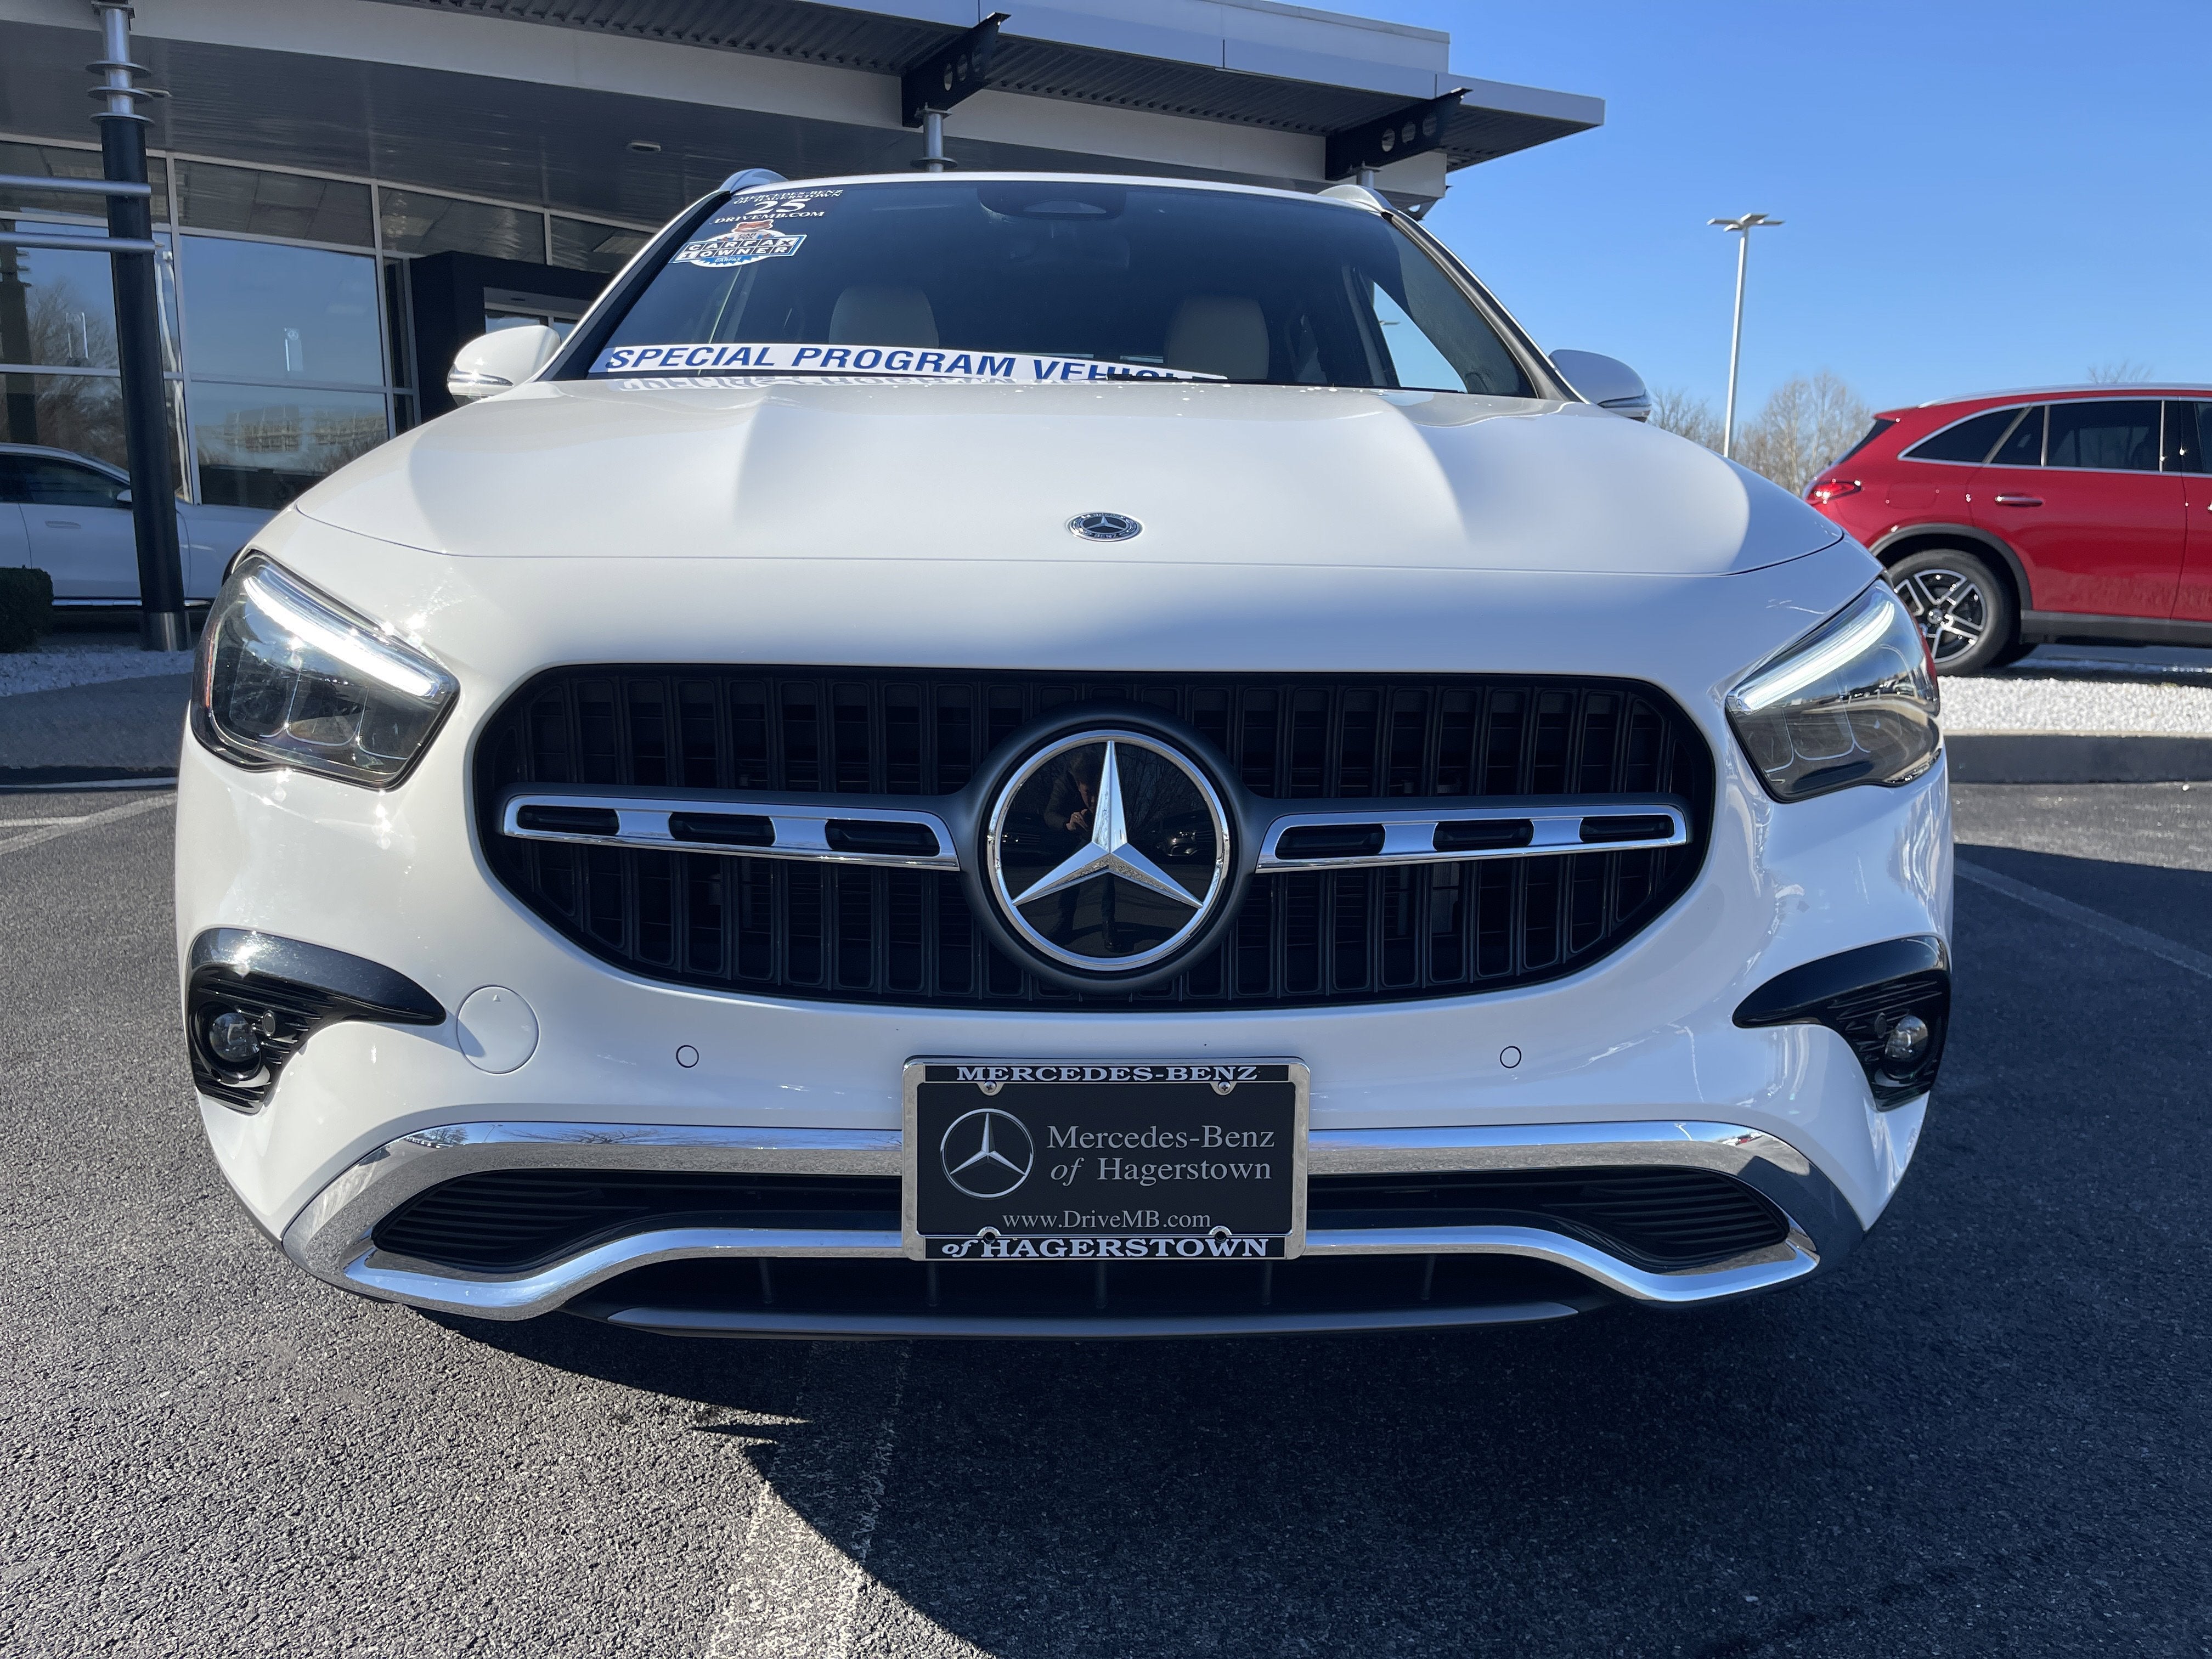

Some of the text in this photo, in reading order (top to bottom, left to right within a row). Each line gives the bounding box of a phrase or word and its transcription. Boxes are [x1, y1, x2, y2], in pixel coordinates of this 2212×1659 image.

[745, 198, 812, 215] 25
[714, 211, 826, 224] DRIVEMB.COM
[689, 239, 795, 251] CARFAX
[605, 347, 775, 369] SPECIAL
[792, 348, 1018, 377] PROGRAM
[956, 1066, 1259, 1081] MERCEDES-BENZ
[1047, 1125, 1276, 1149] Mercedes-Benz
[1051, 1157, 1272, 1186] of Hagerstown
[1003, 1210, 1211, 1229] www.DriveMB.com
[942, 1238, 1268, 1257] of HAGERSTOWN
